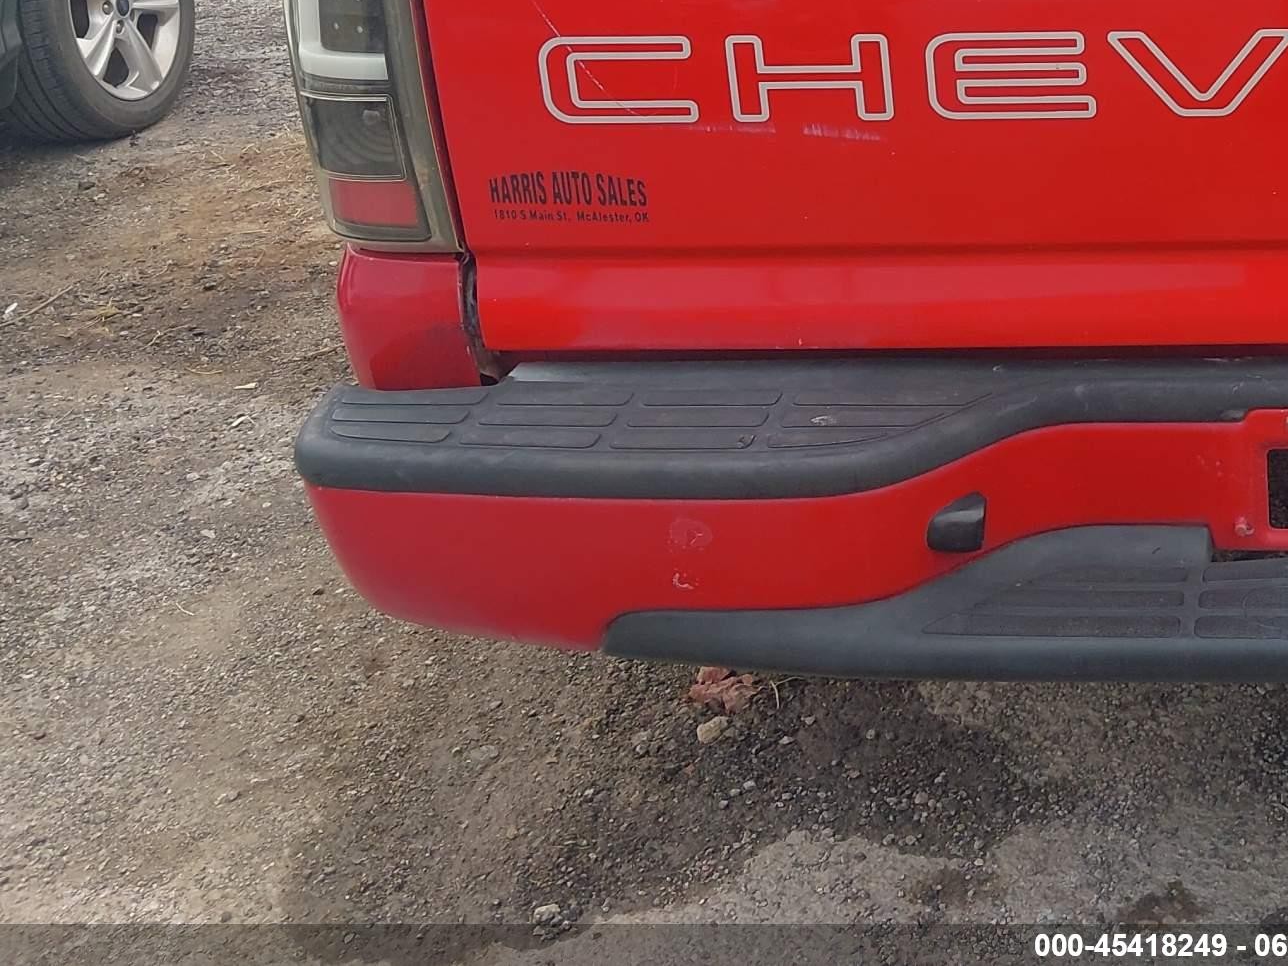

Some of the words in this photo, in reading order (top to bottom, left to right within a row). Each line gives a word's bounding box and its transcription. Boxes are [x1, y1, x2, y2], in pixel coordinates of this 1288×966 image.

[489, 171, 547, 203] HARRIS
[552, 171, 593, 205] AUTO
[596, 173, 647, 206] SALES
[494, 209, 517, 220] 1810
[520, 209, 526, 219] S
[529, 210, 553, 221] Main
[634, 212, 648, 223] OK
